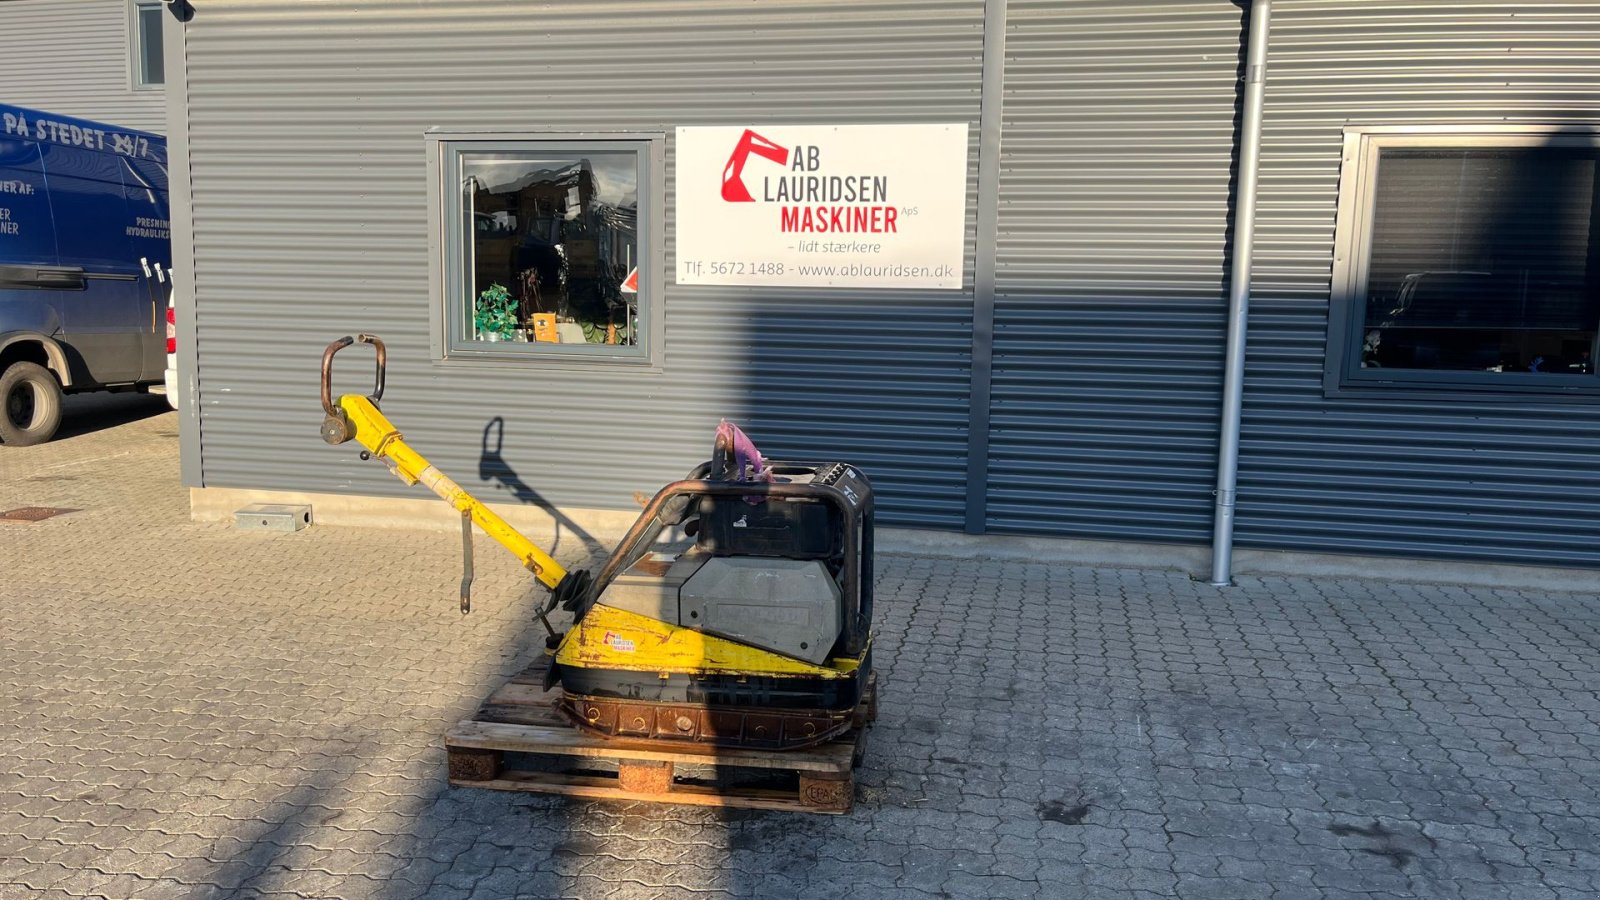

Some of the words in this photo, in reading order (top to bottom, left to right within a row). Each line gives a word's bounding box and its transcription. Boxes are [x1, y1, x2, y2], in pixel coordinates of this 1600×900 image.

[3, 112, 29, 137] PÅ
[36, 119, 105, 150] STEDET
[112, 133, 149, 158] 24/7
[791, 145, 820, 172] AB
[19, 182, 35, 195] AF:
[763, 175, 888, 203] LAURIDSEN
[780, 206, 898, 233] MASKINER
[900, 206, 919, 216] ApS
[798, 240, 820, 253] lidt
[822, 241, 881, 254] stærkere
[684, 260, 706, 277] Tlf.
[710, 261, 745, 275] 5672
[749, 262, 785, 275] 1488
[798, 263, 953, 278] www.ablauridsen.dk
